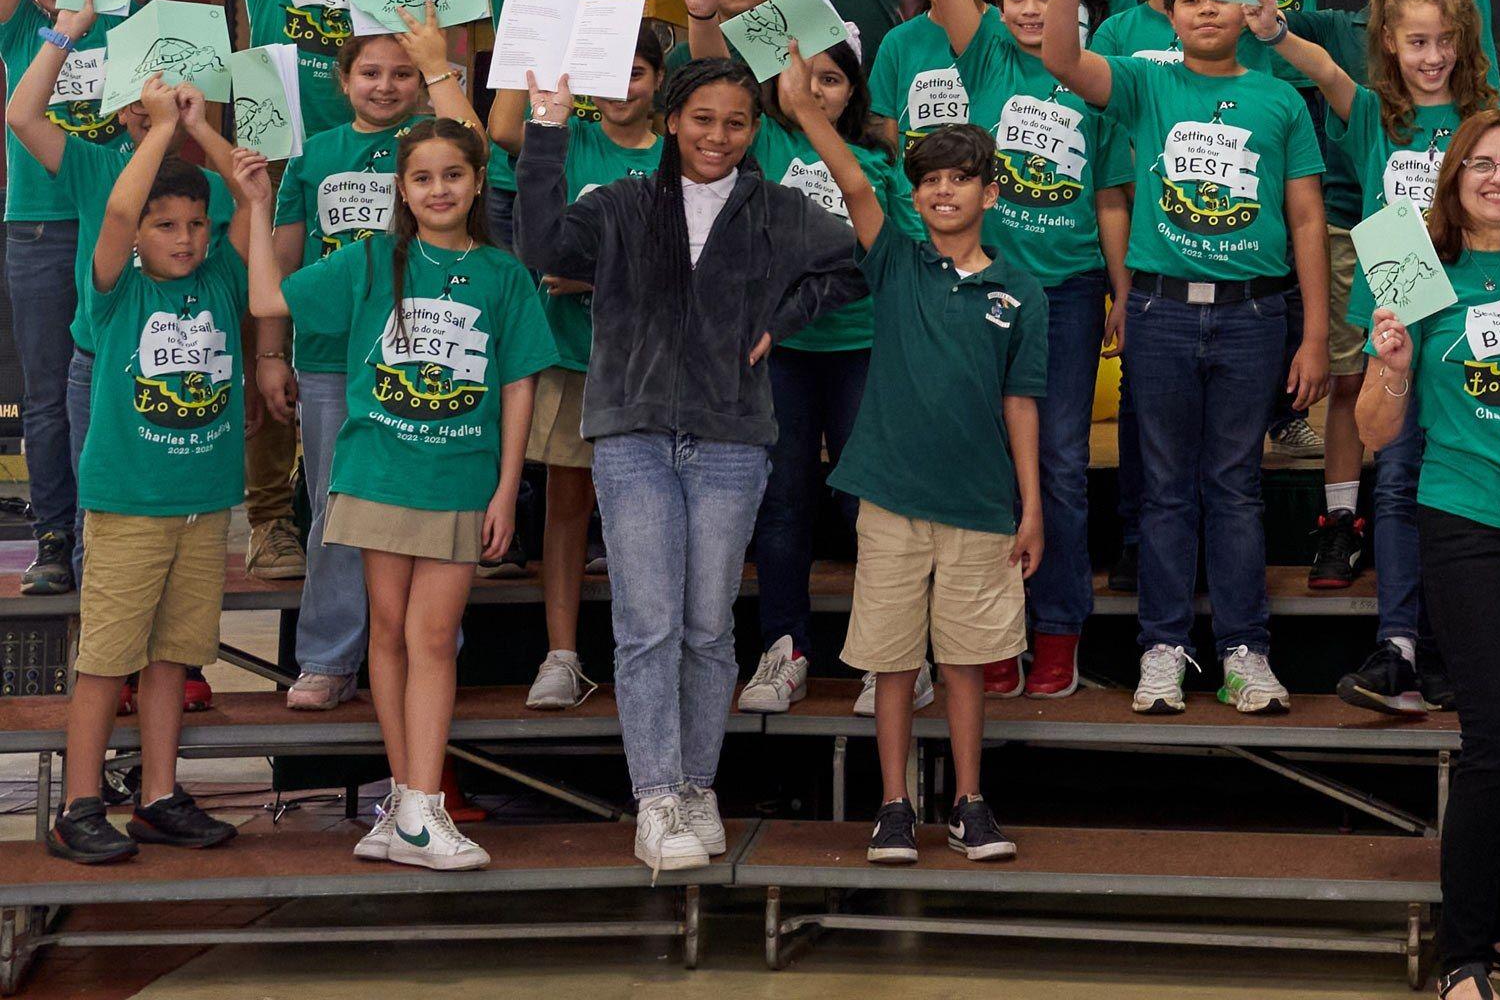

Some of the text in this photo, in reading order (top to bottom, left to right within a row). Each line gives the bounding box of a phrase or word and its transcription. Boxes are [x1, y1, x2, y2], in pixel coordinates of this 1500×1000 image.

[75, 59, 98, 69] Sail
[299, 58, 328, 71] arles
[54, 79, 98, 96] EST
[915, 77, 953, 92] Setting
[918, 102, 969, 119] BEST
[1220, 101, 1235, 110] A+
[1009, 101, 1071, 128] Setting Sail
[1030, 120, 1039, 128] do
[1040, 124, 1052, 132] our
[1435, 129, 1450, 137] A+
[1006, 125, 1064, 153] BEST
[1173, 130, 1238, 150] Setting Sail
[1196, 146, 1206, 154] do
[1175, 156, 1233, 178] BEST
[1391, 160, 1430, 173] Setting
[323, 181, 392, 194] Setting Sail
[1395, 181, 1435, 202] BES
[328, 206, 388, 225] BEST
[994, 202, 1076, 228] arles R. Hadley
[1157, 223, 1259, 252] Charles R. Hadley
[450, 275, 467, 284] A+
[398, 308, 466, 329] Setting Sail
[190, 322, 212, 335] Sail
[421, 325, 431, 334] do
[433, 328, 446, 336] our
[167, 336, 175, 344] to
[396, 337, 459, 359] BEST
[154, 348, 212, 366] BEST
[369, 411, 482, 437] Charles R. Hadley
[138, 426, 184, 445] Charles
[190, 433, 203, 444] R.
